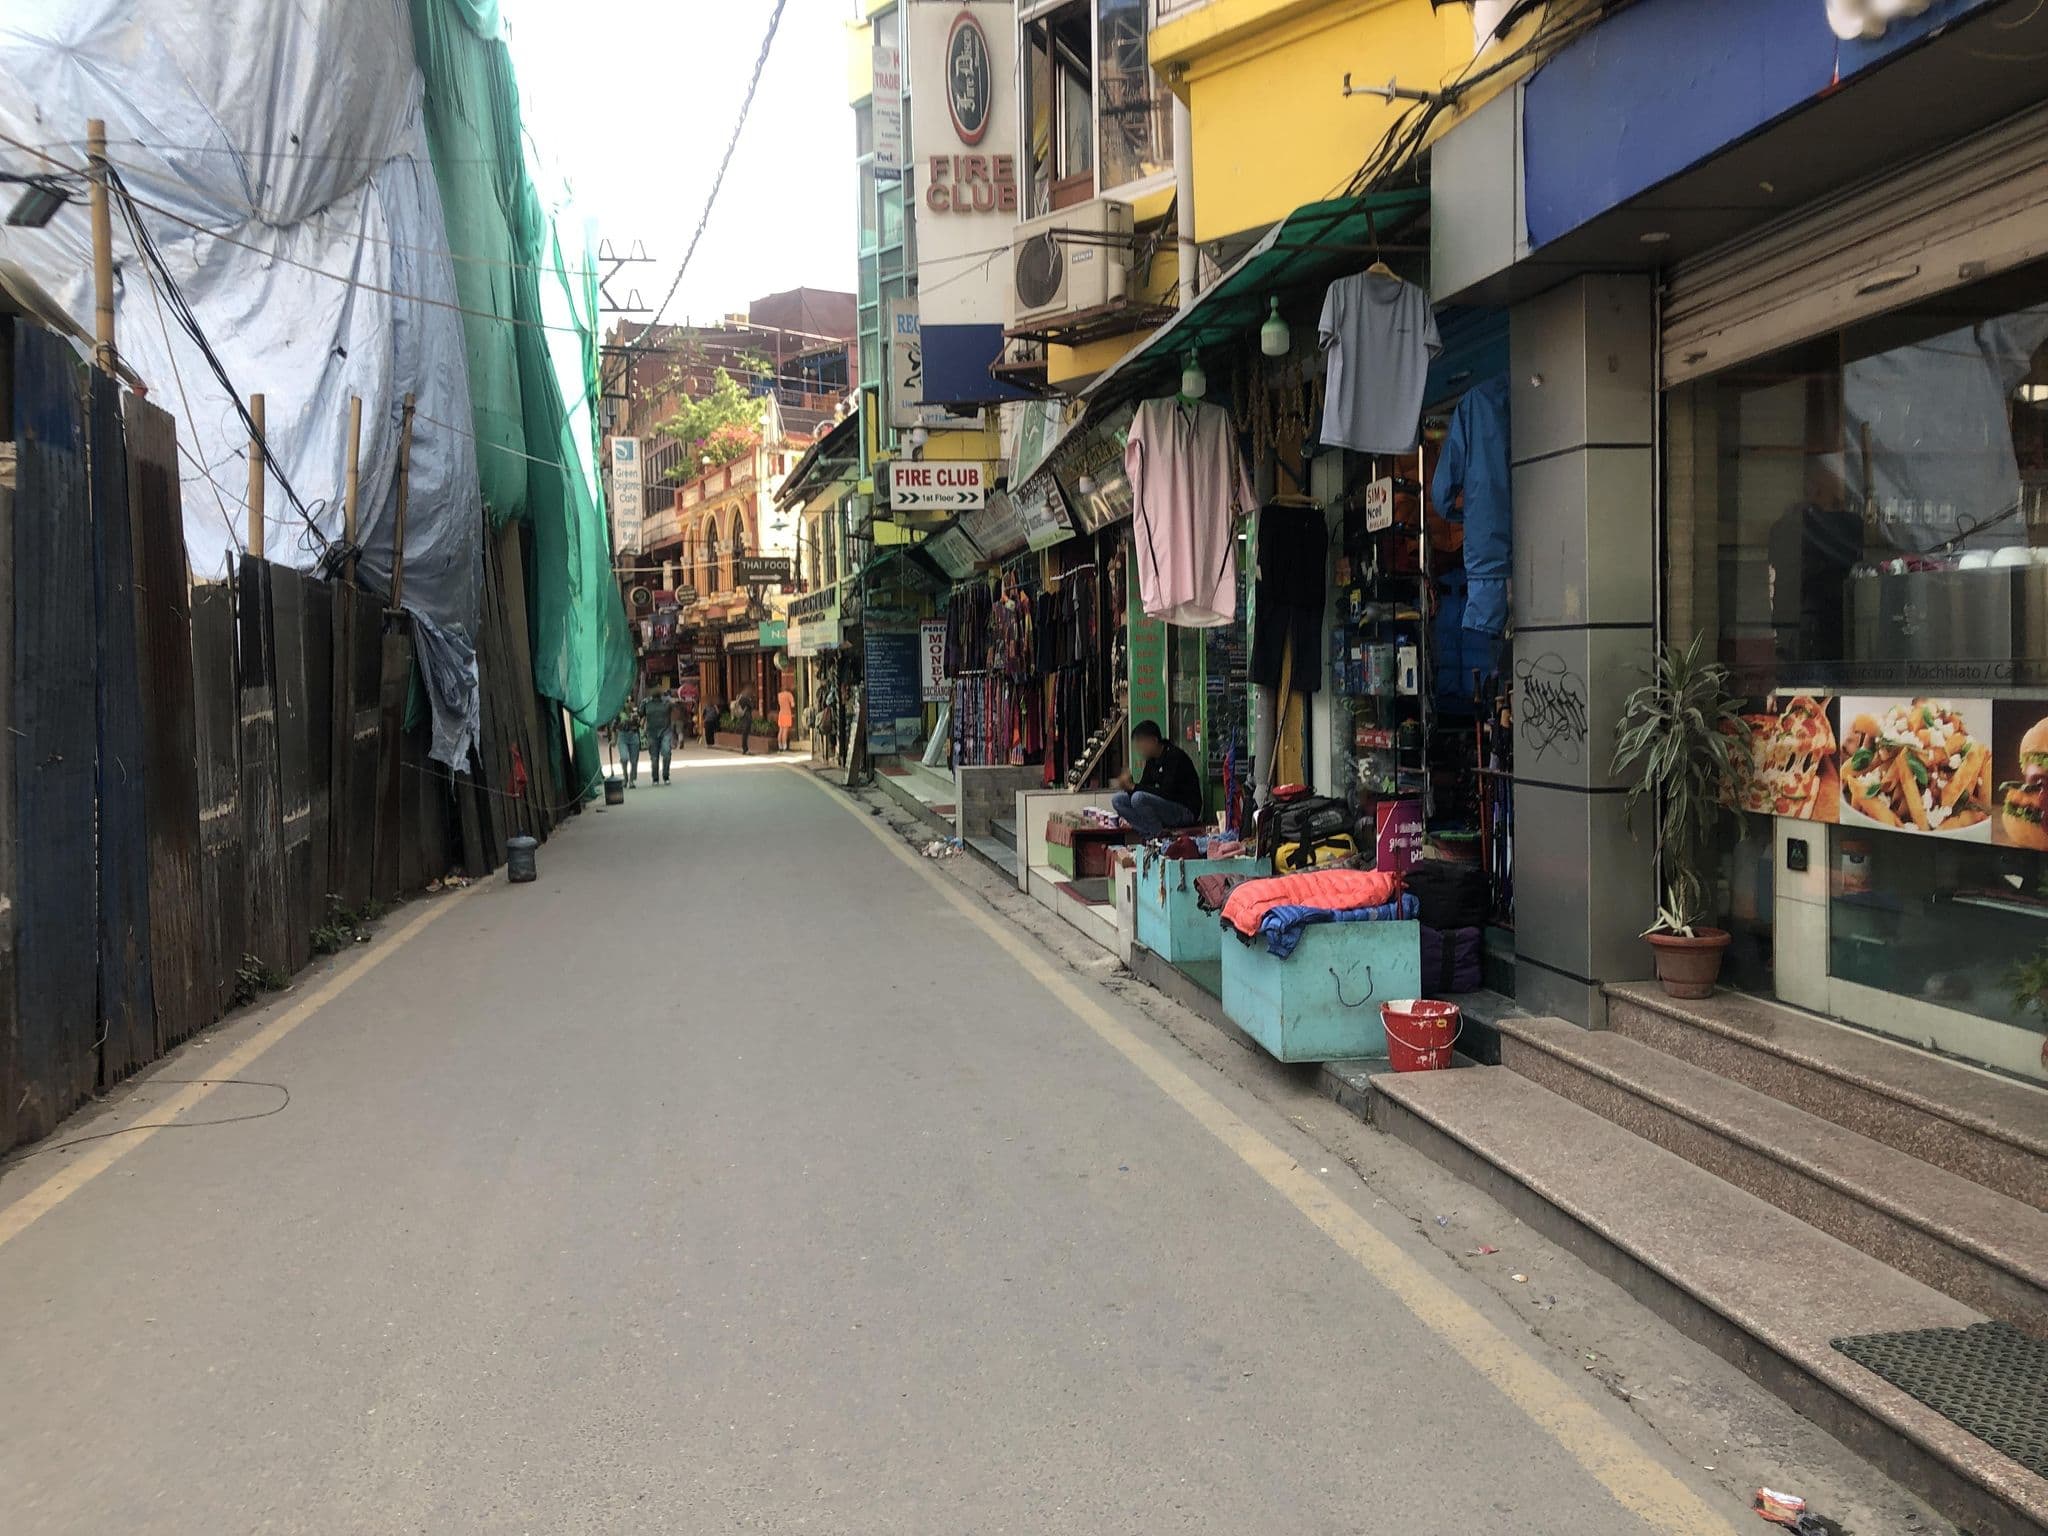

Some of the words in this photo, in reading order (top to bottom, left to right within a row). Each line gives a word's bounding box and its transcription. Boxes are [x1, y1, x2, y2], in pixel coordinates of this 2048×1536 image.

[929, 153, 1014, 184] FIRE
[926, 183, 1018, 213] CLUB
[616, 468, 638, 478] Green
[895, 468, 932, 487] FIRE
[936, 468, 979, 487] CLUB
[922, 493, 934, 503] 1st
[935, 493, 955, 503] Floor
[1368, 486, 1381, 504] SIM
[742, 560, 762, 570] THAI
[764, 560, 789, 570] FOOD
[928, 633, 943, 687] MONEY
